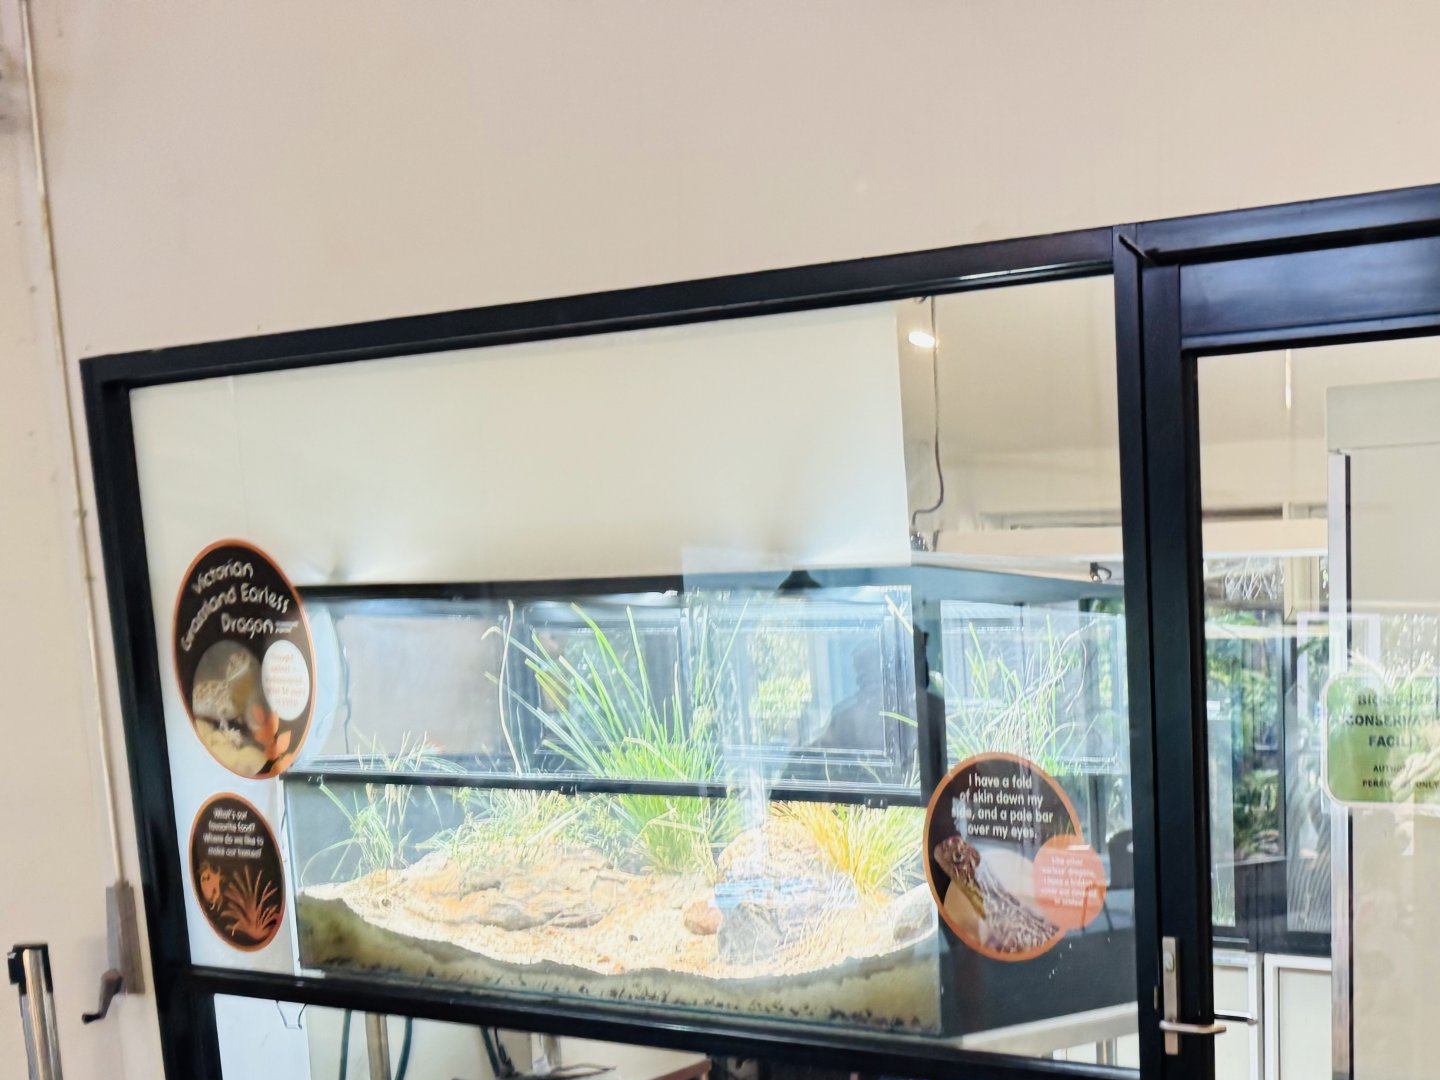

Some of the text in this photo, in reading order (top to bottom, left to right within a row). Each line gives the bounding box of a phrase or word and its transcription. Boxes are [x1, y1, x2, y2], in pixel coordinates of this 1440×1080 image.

[192, 558, 254, 594] Victorian
[181, 582, 290, 652] Grassland Earless
[221, 612, 274, 639] Dragon
[968, 773, 1032, 789] I have a fold
[960, 788, 1043, 808] of skin down my
[978, 806, 997, 820] and
[1000, 810, 1007, 820] a
[1010, 807, 1033, 824] pale
[1036, 808, 1054, 823] bar
[968, 824, 989, 835] over
[992, 826, 1008, 839] my
